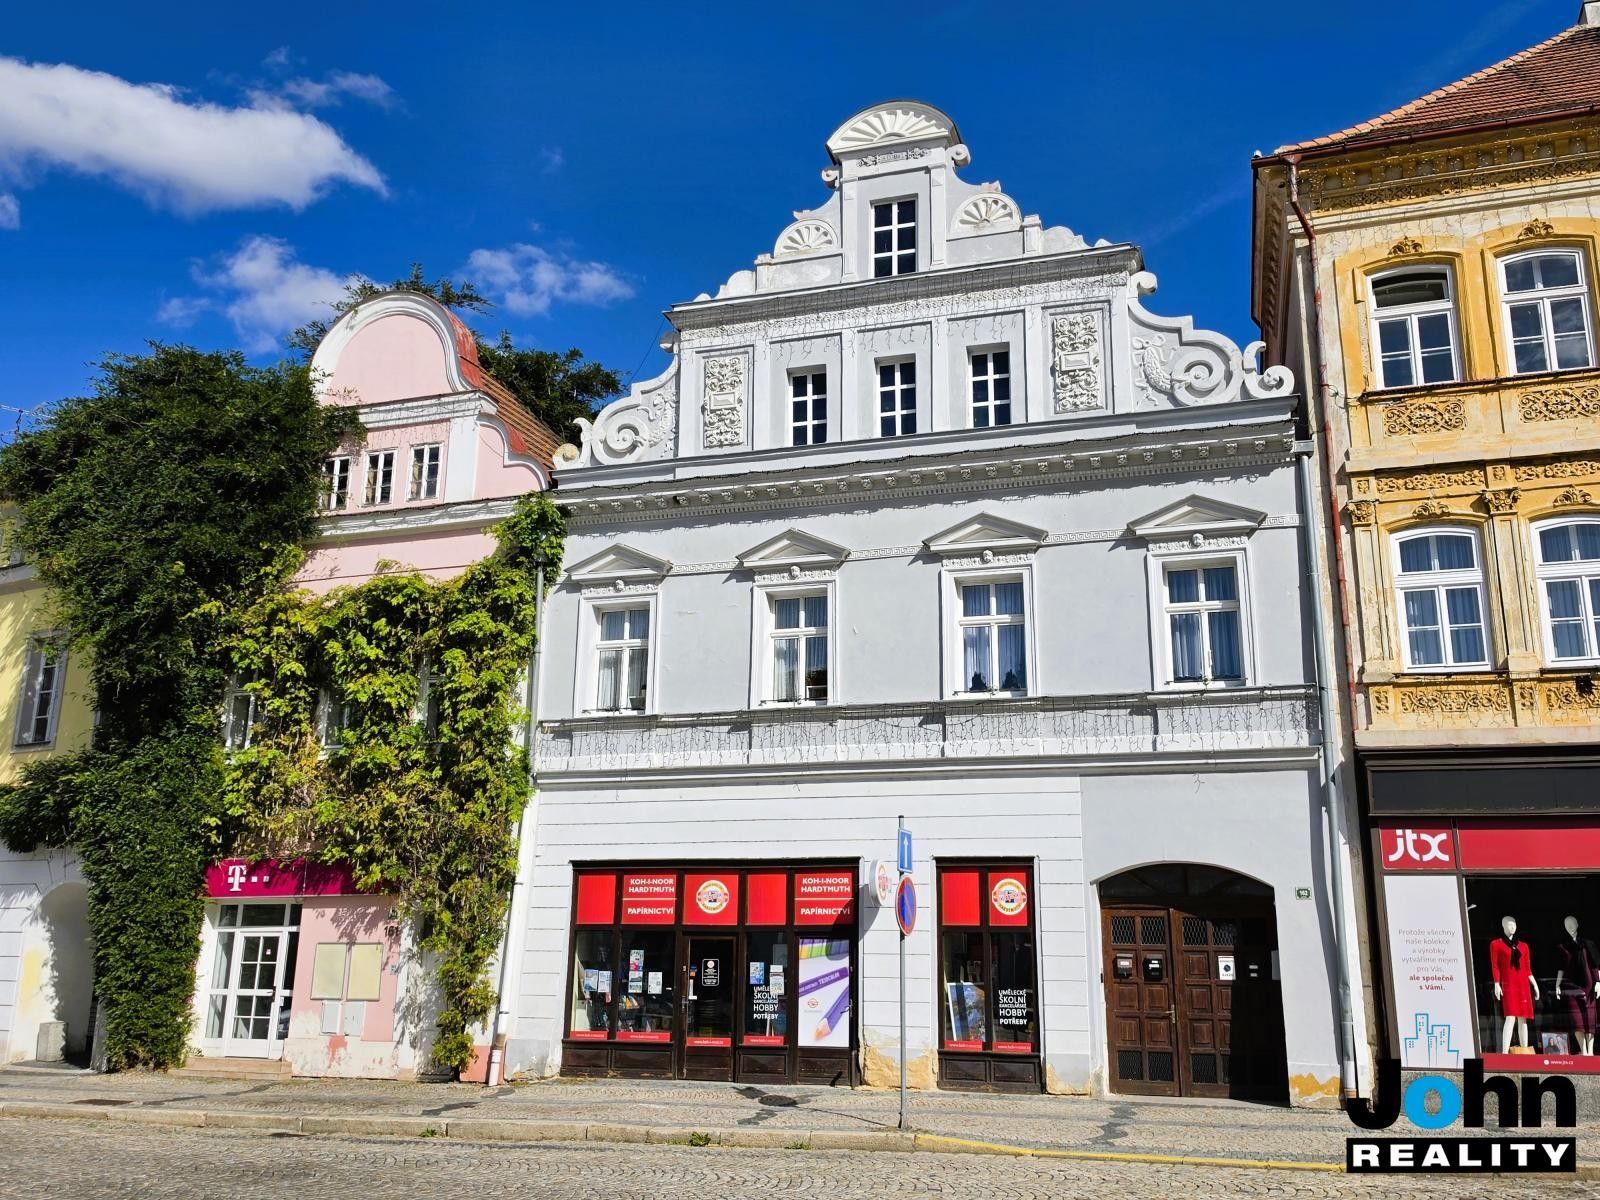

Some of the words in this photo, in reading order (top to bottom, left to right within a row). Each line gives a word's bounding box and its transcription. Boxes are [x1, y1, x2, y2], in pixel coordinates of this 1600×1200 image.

[1388, 828, 1450, 862] jtx
[802, 877, 849, 885] KOH-I-NOOR
[627, 906, 674, 915] PAPÍRNICTVÍ
[800, 906, 850, 915] PAPÍRNICTVÍ
[1422, 974, 1454, 983] společně
[998, 988, 1027, 996] UMĚLECKÉ
[998, 994, 1027, 1003] ŠKOLNÍ
[753, 1004, 779, 1012] HOBBY
[999, 1008, 1027, 1017] HOBBY
[753, 1012, 779, 1020] POTŘEBY
[999, 1017, 1028, 1025] POTŘEBY
